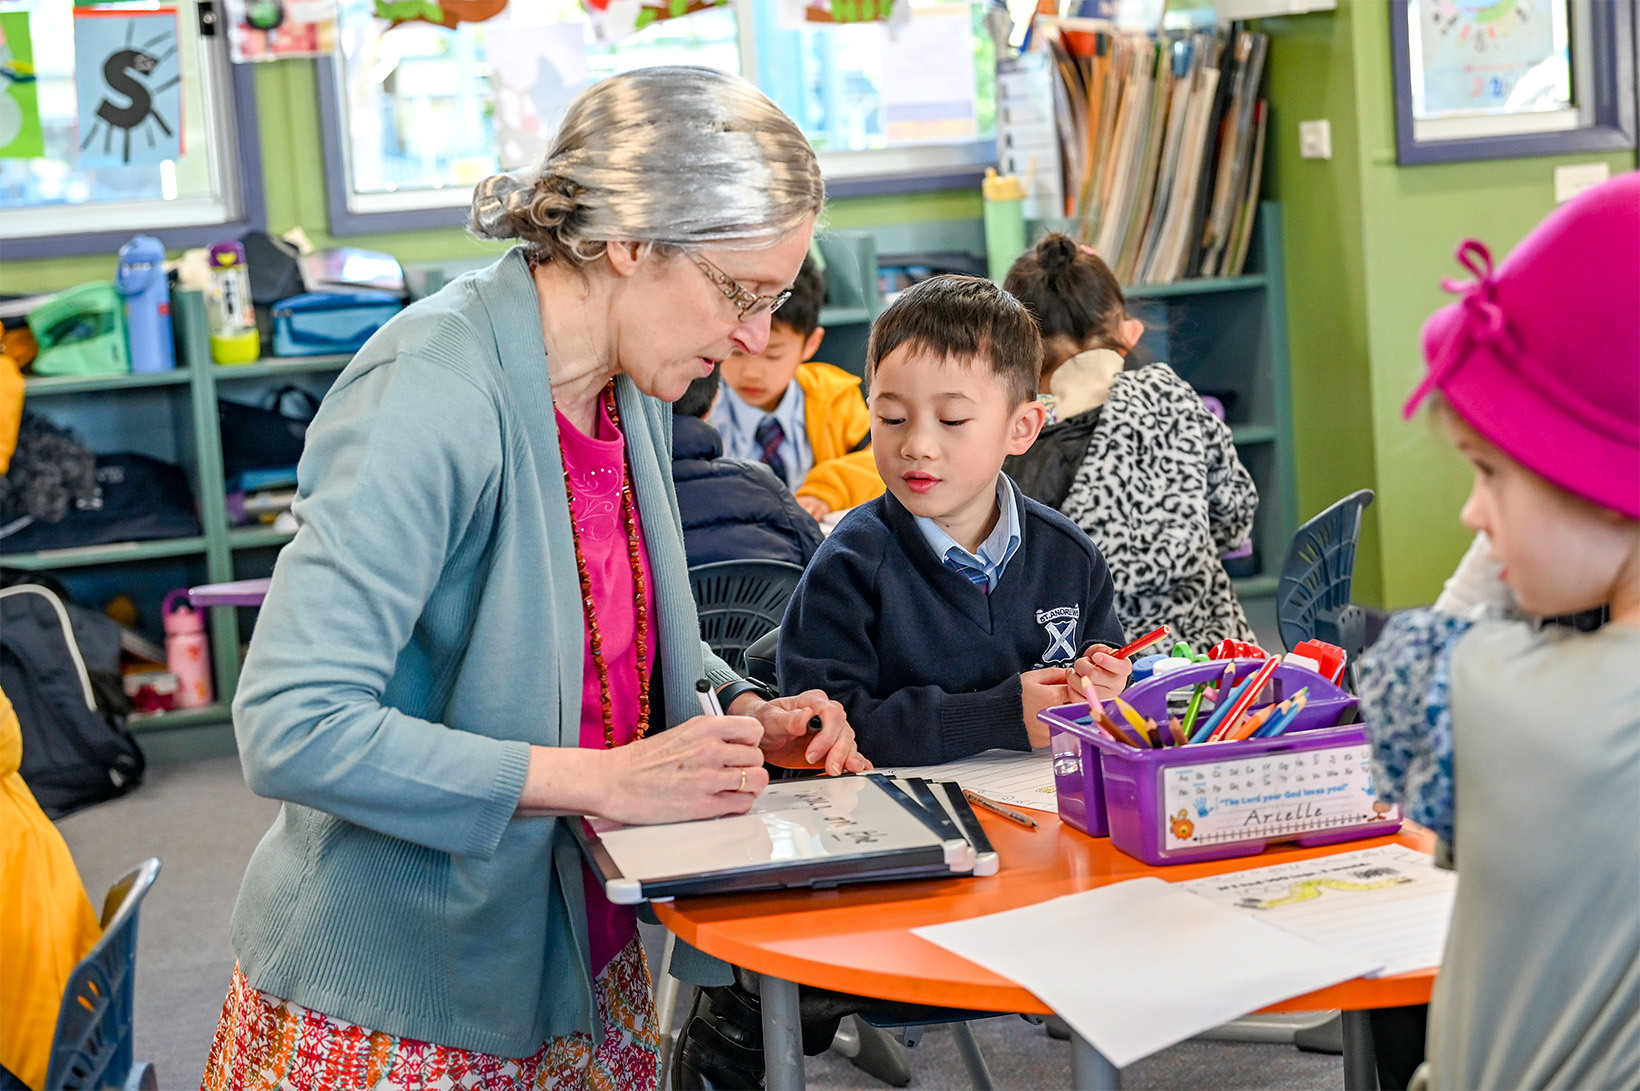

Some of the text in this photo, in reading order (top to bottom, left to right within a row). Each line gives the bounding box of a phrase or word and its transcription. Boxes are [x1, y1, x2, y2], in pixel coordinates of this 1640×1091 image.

[97, 50, 158, 129] S
[1241, 795, 1261, 804] Lord
[1263, 793, 1282, 803] your
[1284, 790, 1301, 799] God
[1303, 788, 1325, 796] loves
[1243, 803, 1323, 826] Arielle
